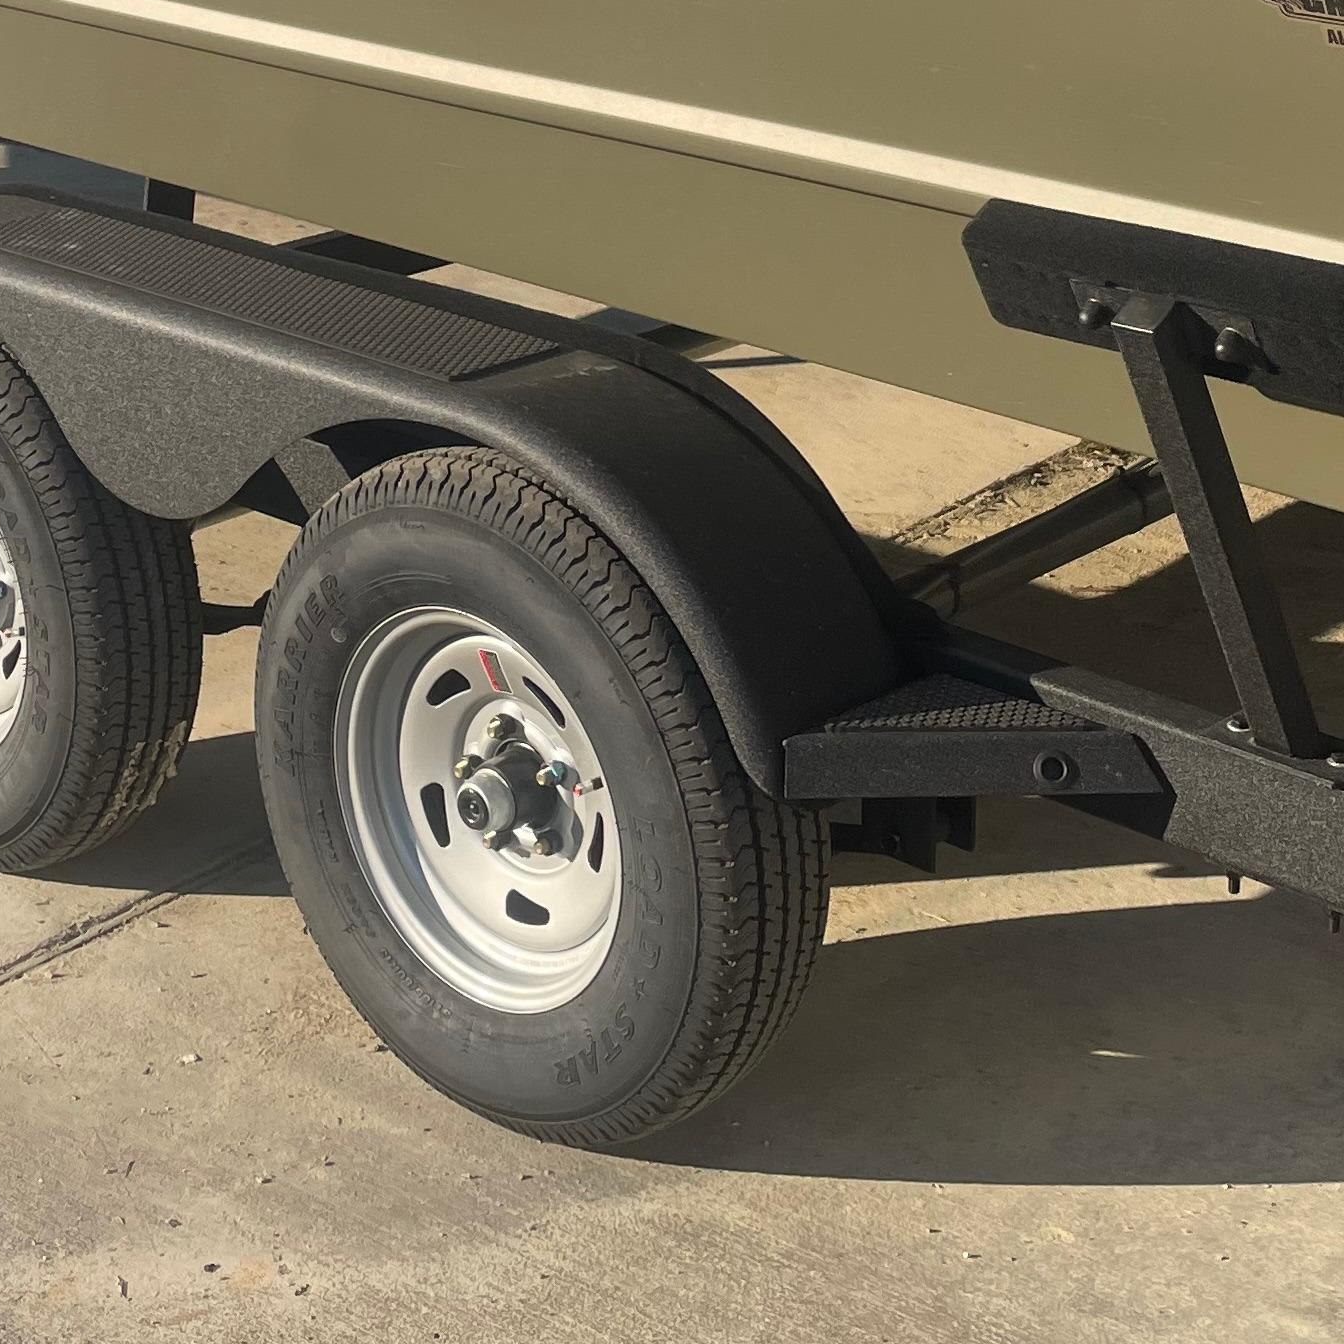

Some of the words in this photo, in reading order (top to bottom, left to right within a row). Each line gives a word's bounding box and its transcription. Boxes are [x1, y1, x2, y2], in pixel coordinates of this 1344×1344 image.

[30, 613, 53, 737] STAR
[273, 573, 347, 777] KARRIER
[631, 816, 664, 971] LOAD
[554, 1001, 635, 1088] STAR
